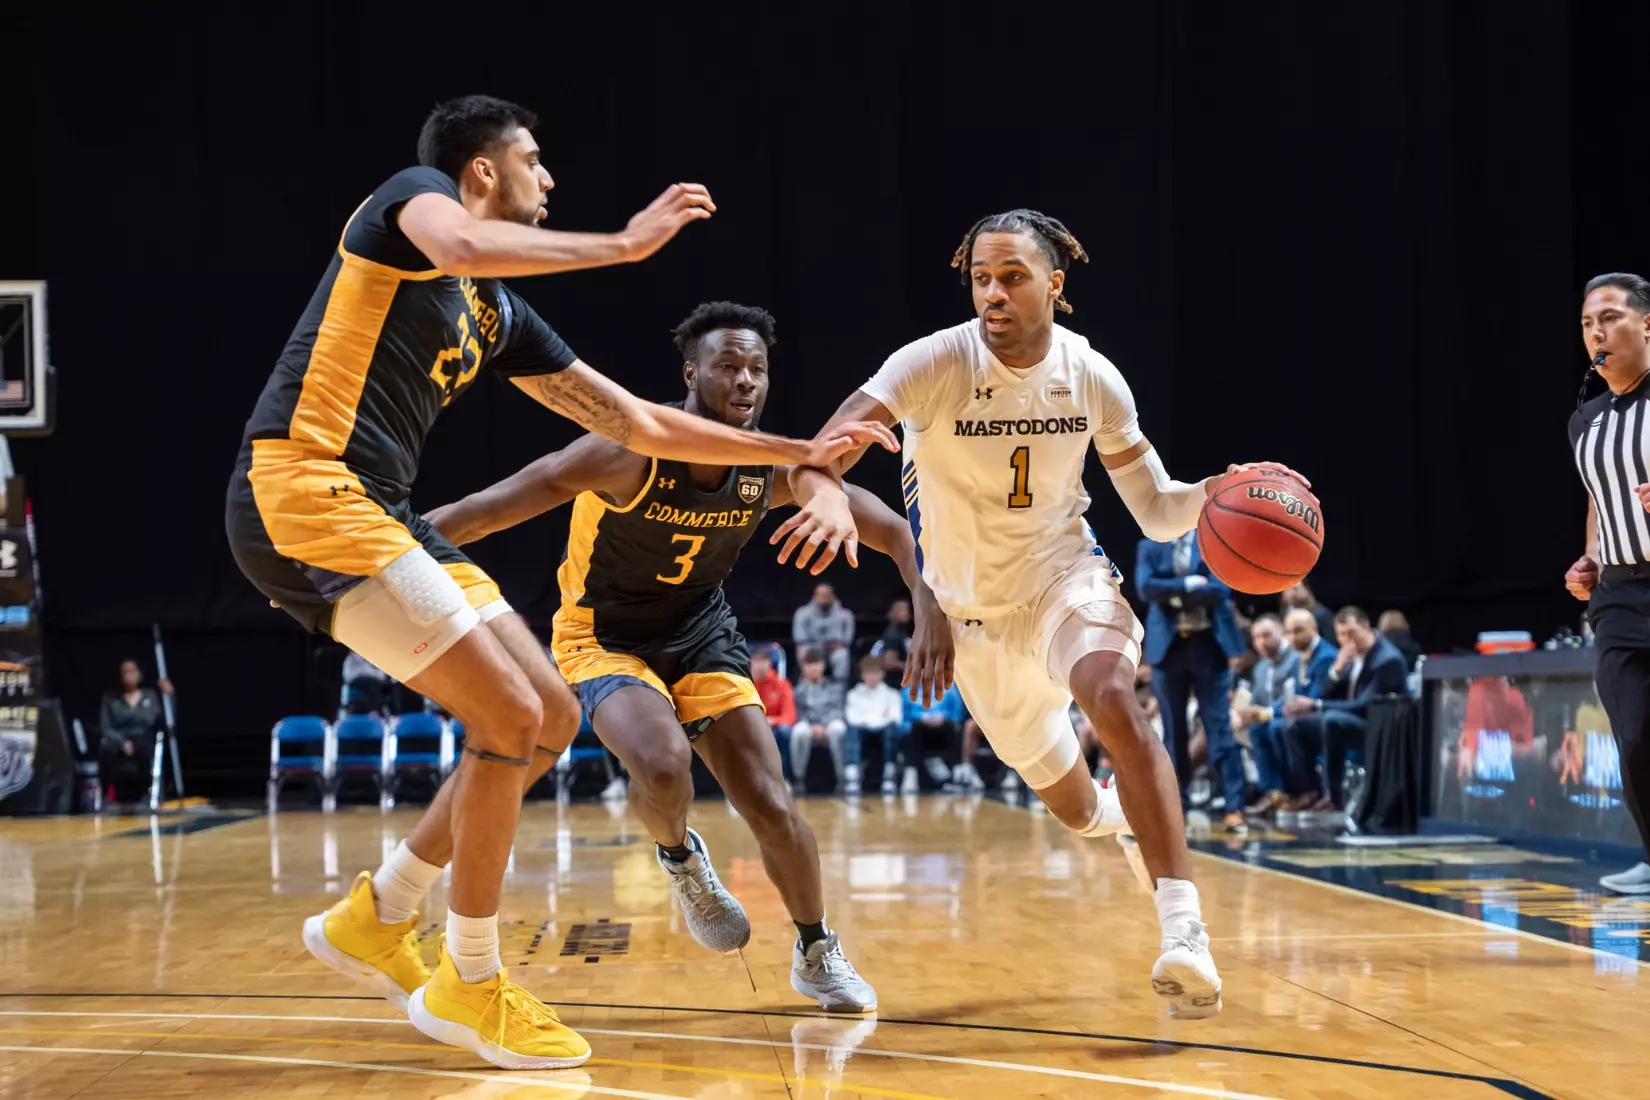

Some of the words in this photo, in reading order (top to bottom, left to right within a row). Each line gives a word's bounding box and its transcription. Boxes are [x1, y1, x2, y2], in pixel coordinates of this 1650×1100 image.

[954, 416, 1088, 437] MASTODONS
[741, 484, 759, 496] 60
[1008, 446, 1033, 508] 1
[644, 502, 753, 528] COMMERCE
[1246, 486, 1320, 534] Wilson
[656, 533, 706, 585] 3
